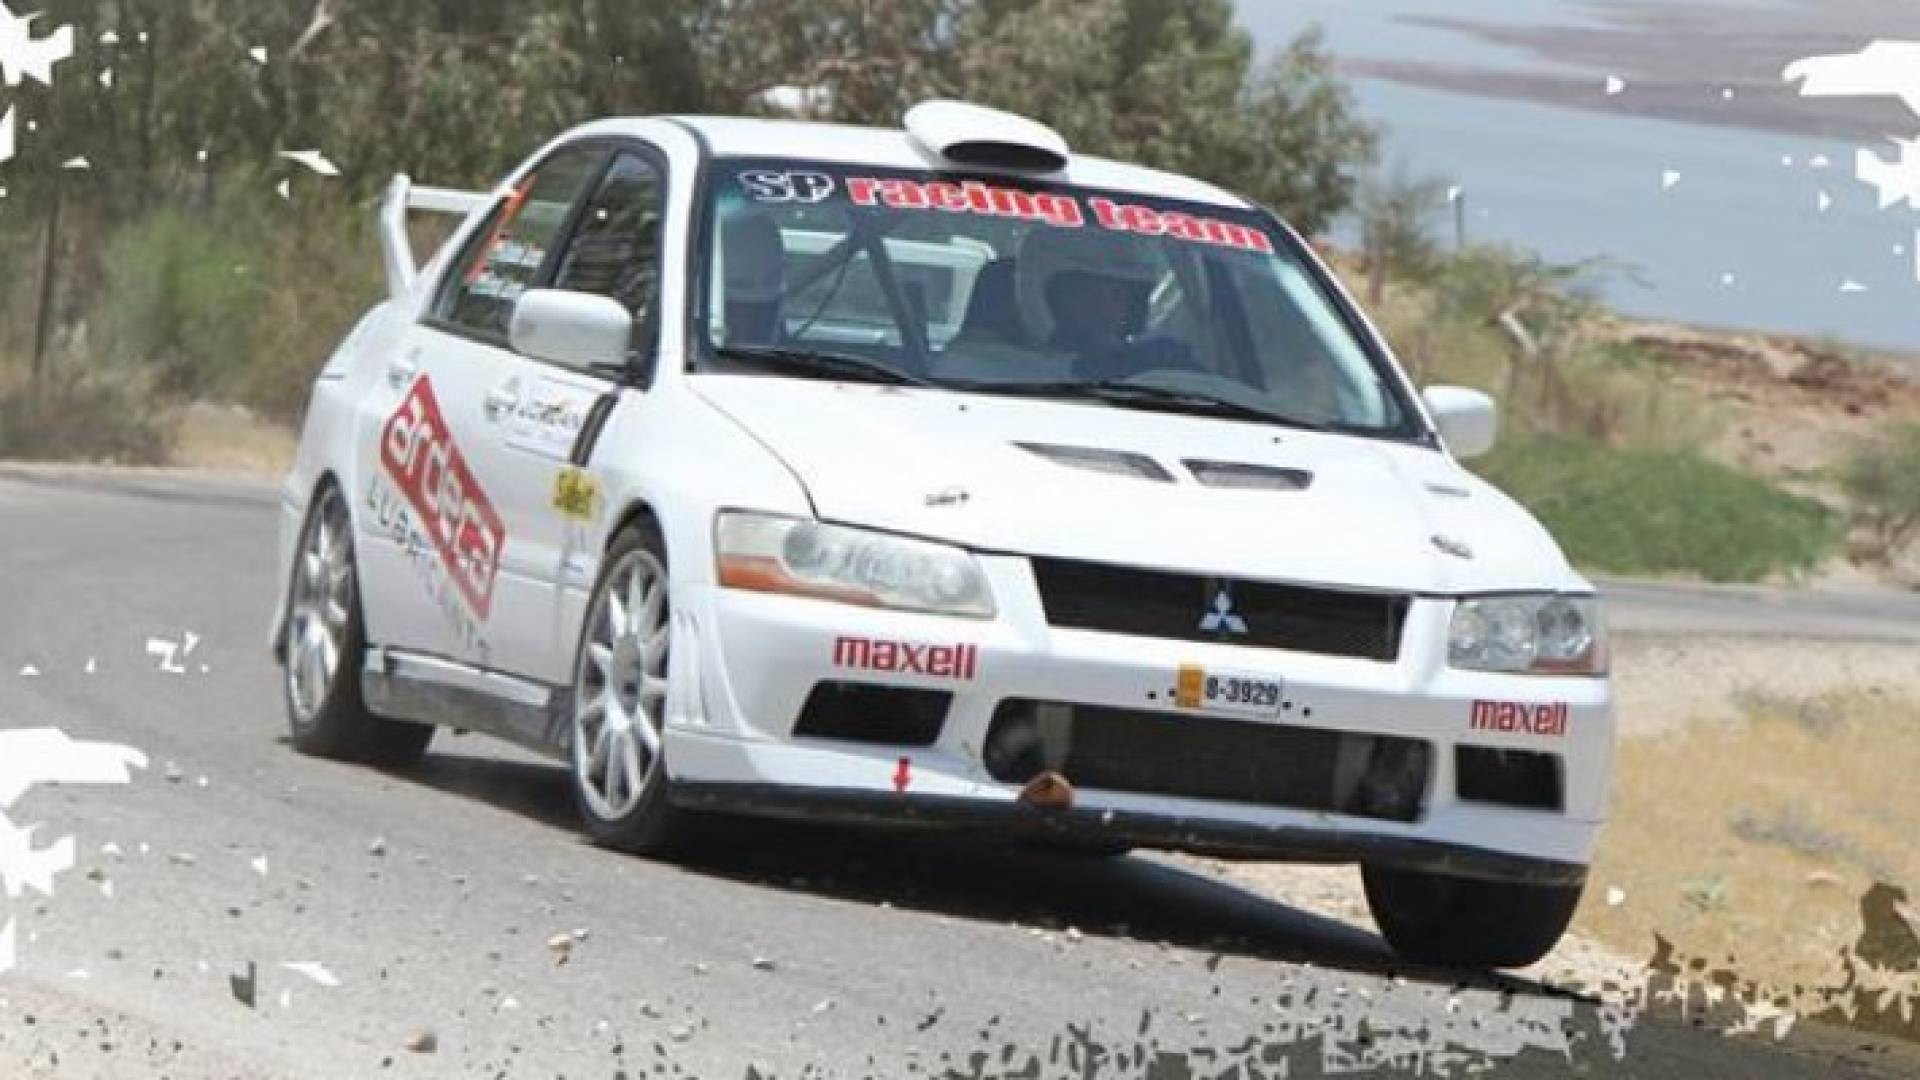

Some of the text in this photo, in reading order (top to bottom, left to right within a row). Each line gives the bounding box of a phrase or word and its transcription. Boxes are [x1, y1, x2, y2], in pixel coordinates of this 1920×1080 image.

[738, 168, 1274, 254] SP racing team
[833, 635, 977, 681] maxell
[1469, 698, 1568, 736] maxell
